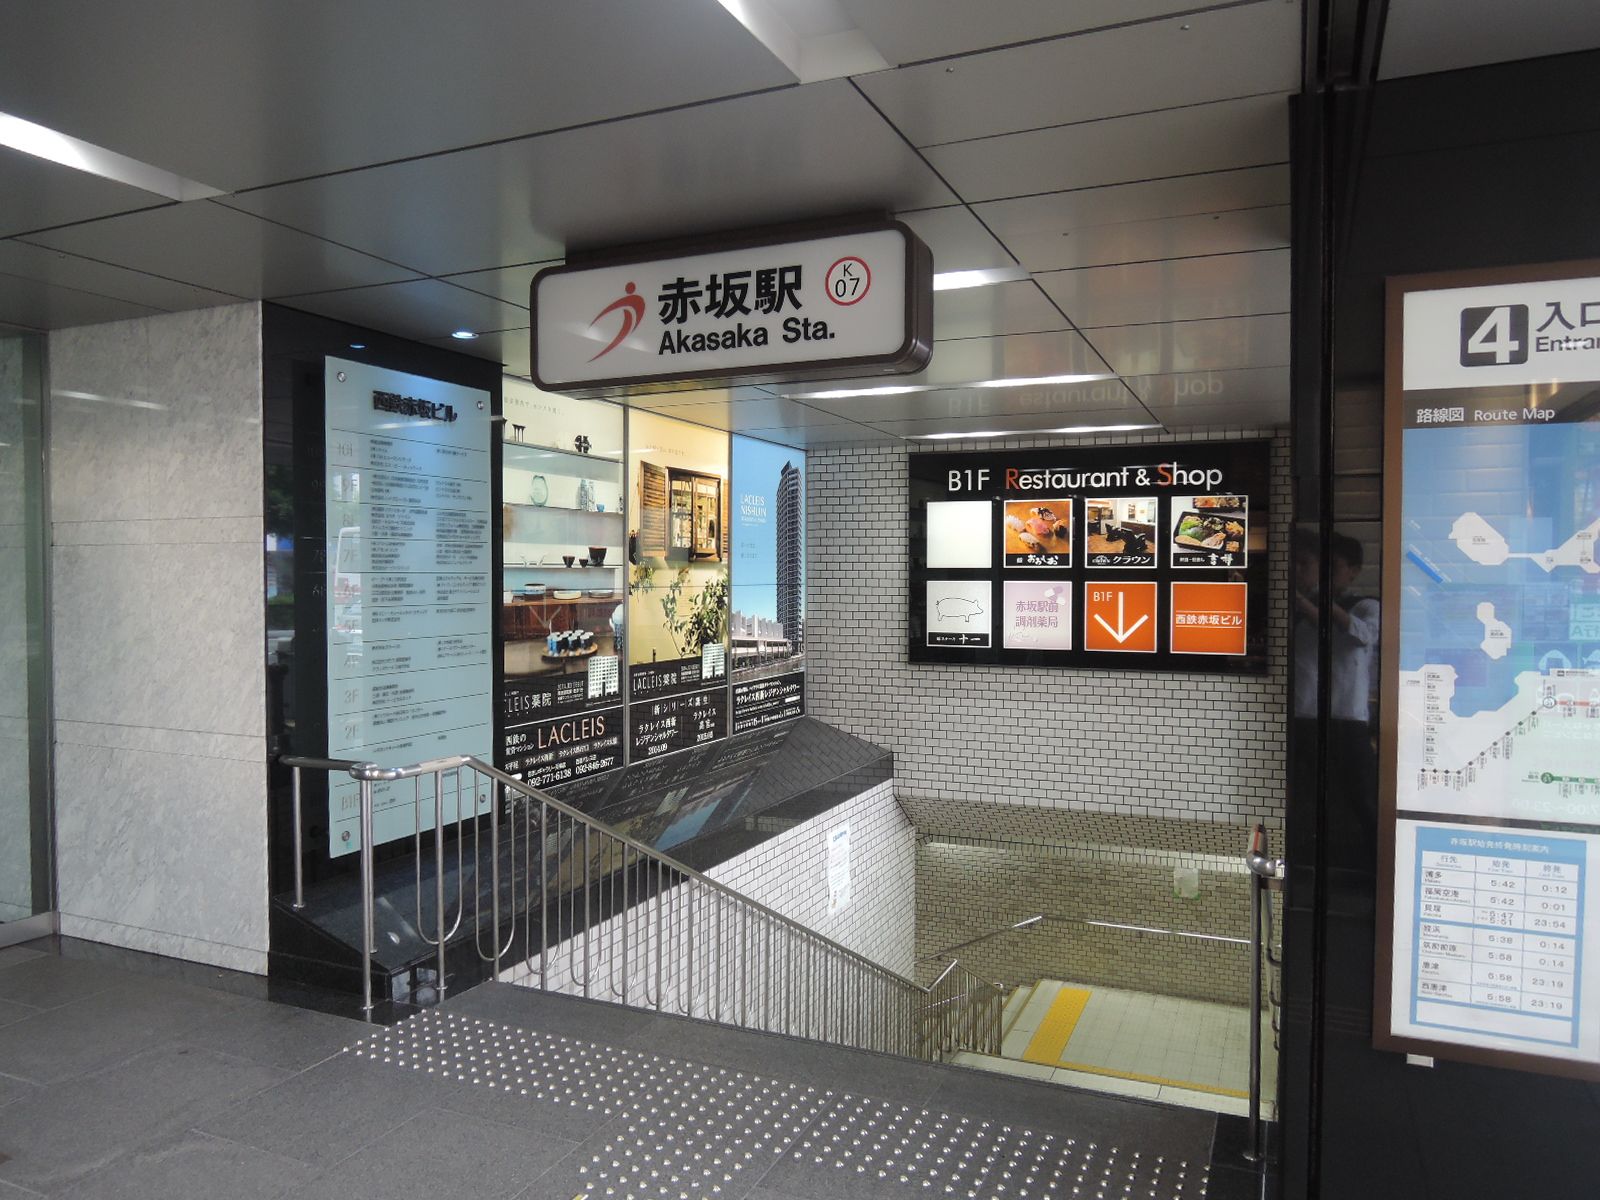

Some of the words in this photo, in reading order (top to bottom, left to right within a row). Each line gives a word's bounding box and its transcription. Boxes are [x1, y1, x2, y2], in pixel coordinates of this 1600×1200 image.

[843, 263, 854, 277] K
[834, 278, 860, 298] 07
[657, 264, 803, 325] 赤坂駅
[658, 321, 769, 355] Akasaka
[782, 316, 836, 344] Sta.
[1467, 306, 1519, 364] 4
[1417, 407, 1465, 423] 路線図
[1474, 409, 1517, 422] Route
[1522, 408, 1555, 422] Map
[948, 469, 990, 491] B1F
[1005, 466, 1129, 490] Restaurant
[1135, 471, 1151, 486] &
[1157, 462, 1223, 490] Shop
[1113, 555, 1151, 564] クラウン
[1093, 592, 1113, 602] B1F
[1016, 600, 1059, 613] 赤坂駅前
[1016, 616, 1059, 628] 調剤薬局
[1175, 614, 1243, 627] 西鉄赤坂ビル
[538, 716, 605, 749] LACLEIS
[1490, 879, 1515, 888] 5:42
[1542, 885, 1567, 894] 0:12
[1490, 897, 1514, 905] 5:42
[1542, 903, 1565, 911] 0:01
[1489, 911, 1514, 919] 5:47
[1489, 918, 1513, 926] 5:51
[1534, 919, 1566, 928] 23:54
[1488, 935, 1513, 944] 5:38
[1540, 941, 1565, 950] 0:14
[1488, 952, 1512, 961] 5:58
[1539, 959, 1564, 968] 0:14
[1488, 972, 1512, 981] 5:58
[1532, 978, 1564, 988] 23:19
[1487, 993, 1512, 1003] 5:58
[1531, 999, 1563, 1009] 23:19
